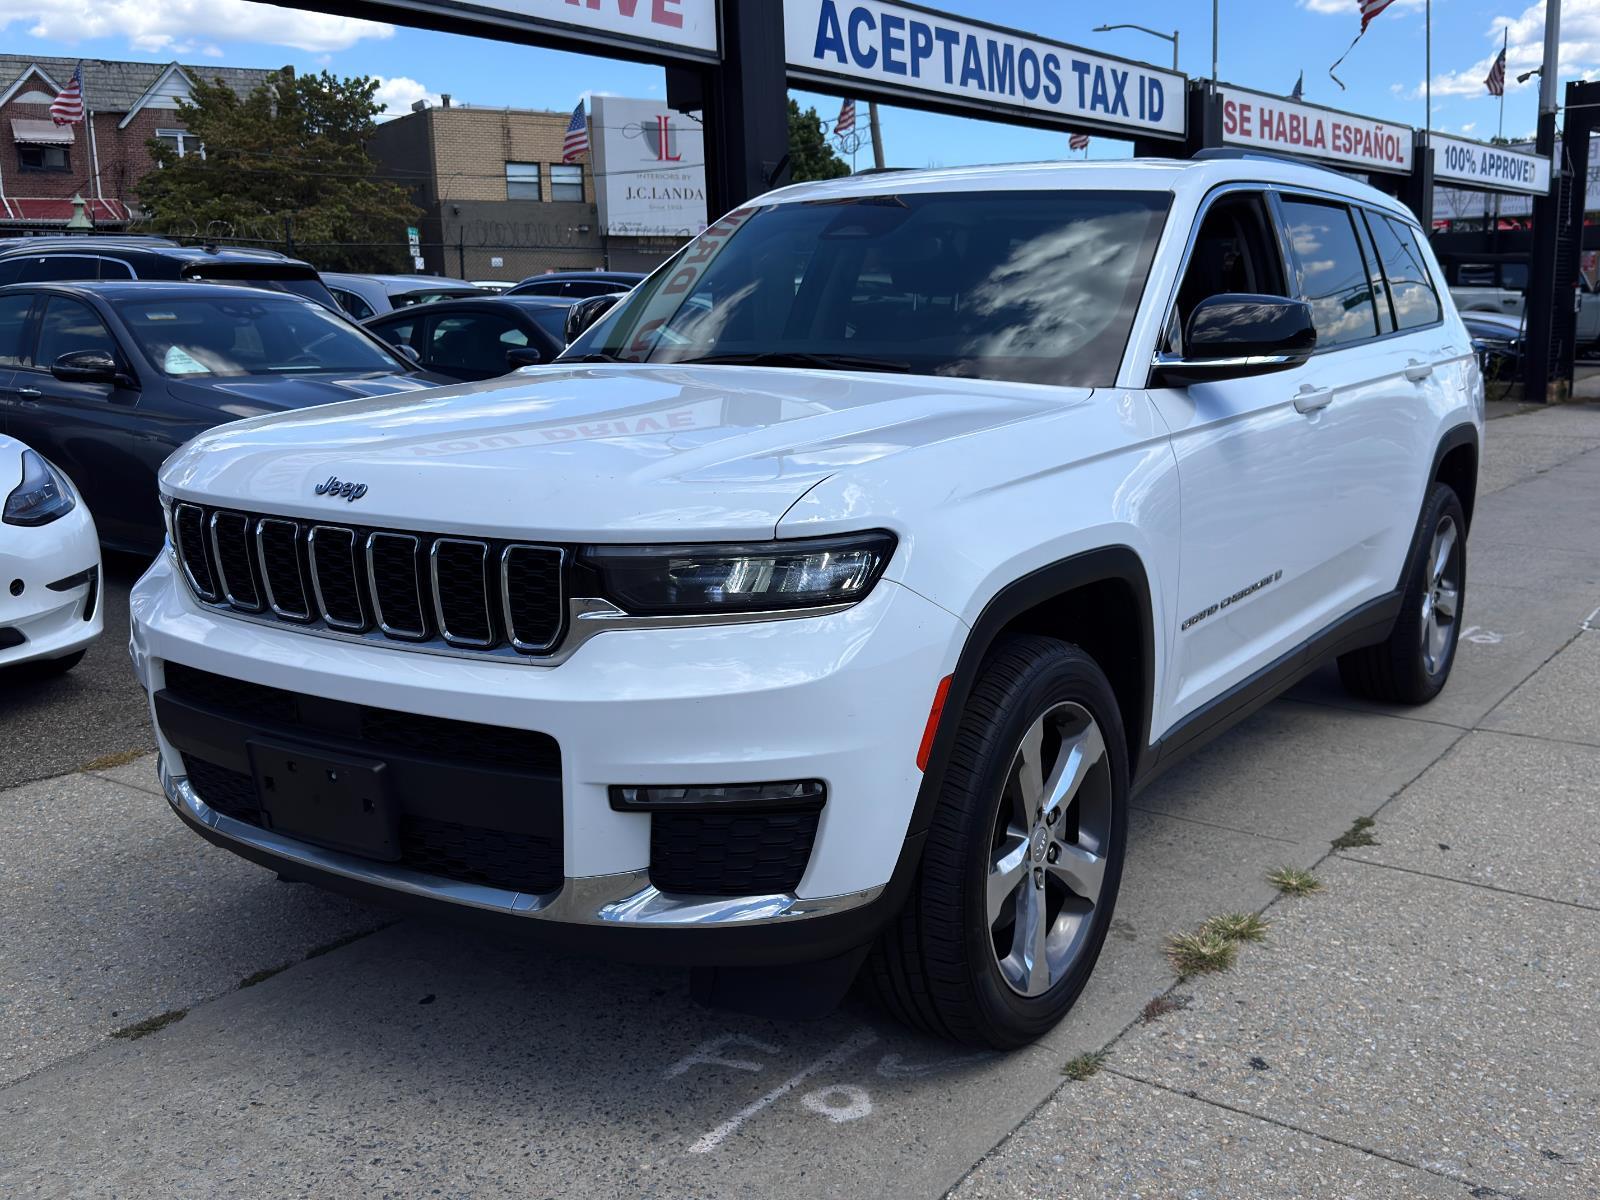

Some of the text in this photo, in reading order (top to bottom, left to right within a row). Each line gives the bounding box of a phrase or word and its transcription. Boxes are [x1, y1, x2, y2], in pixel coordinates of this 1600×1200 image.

[814, 0, 1165, 123] ACEPTAMOS TAX ID
[1223, 100, 1404, 164] SE HABLA ESPAÑOL
[1444, 145, 1536, 184] 100% APPROVED
[315, 476, 368, 502] Jeep
